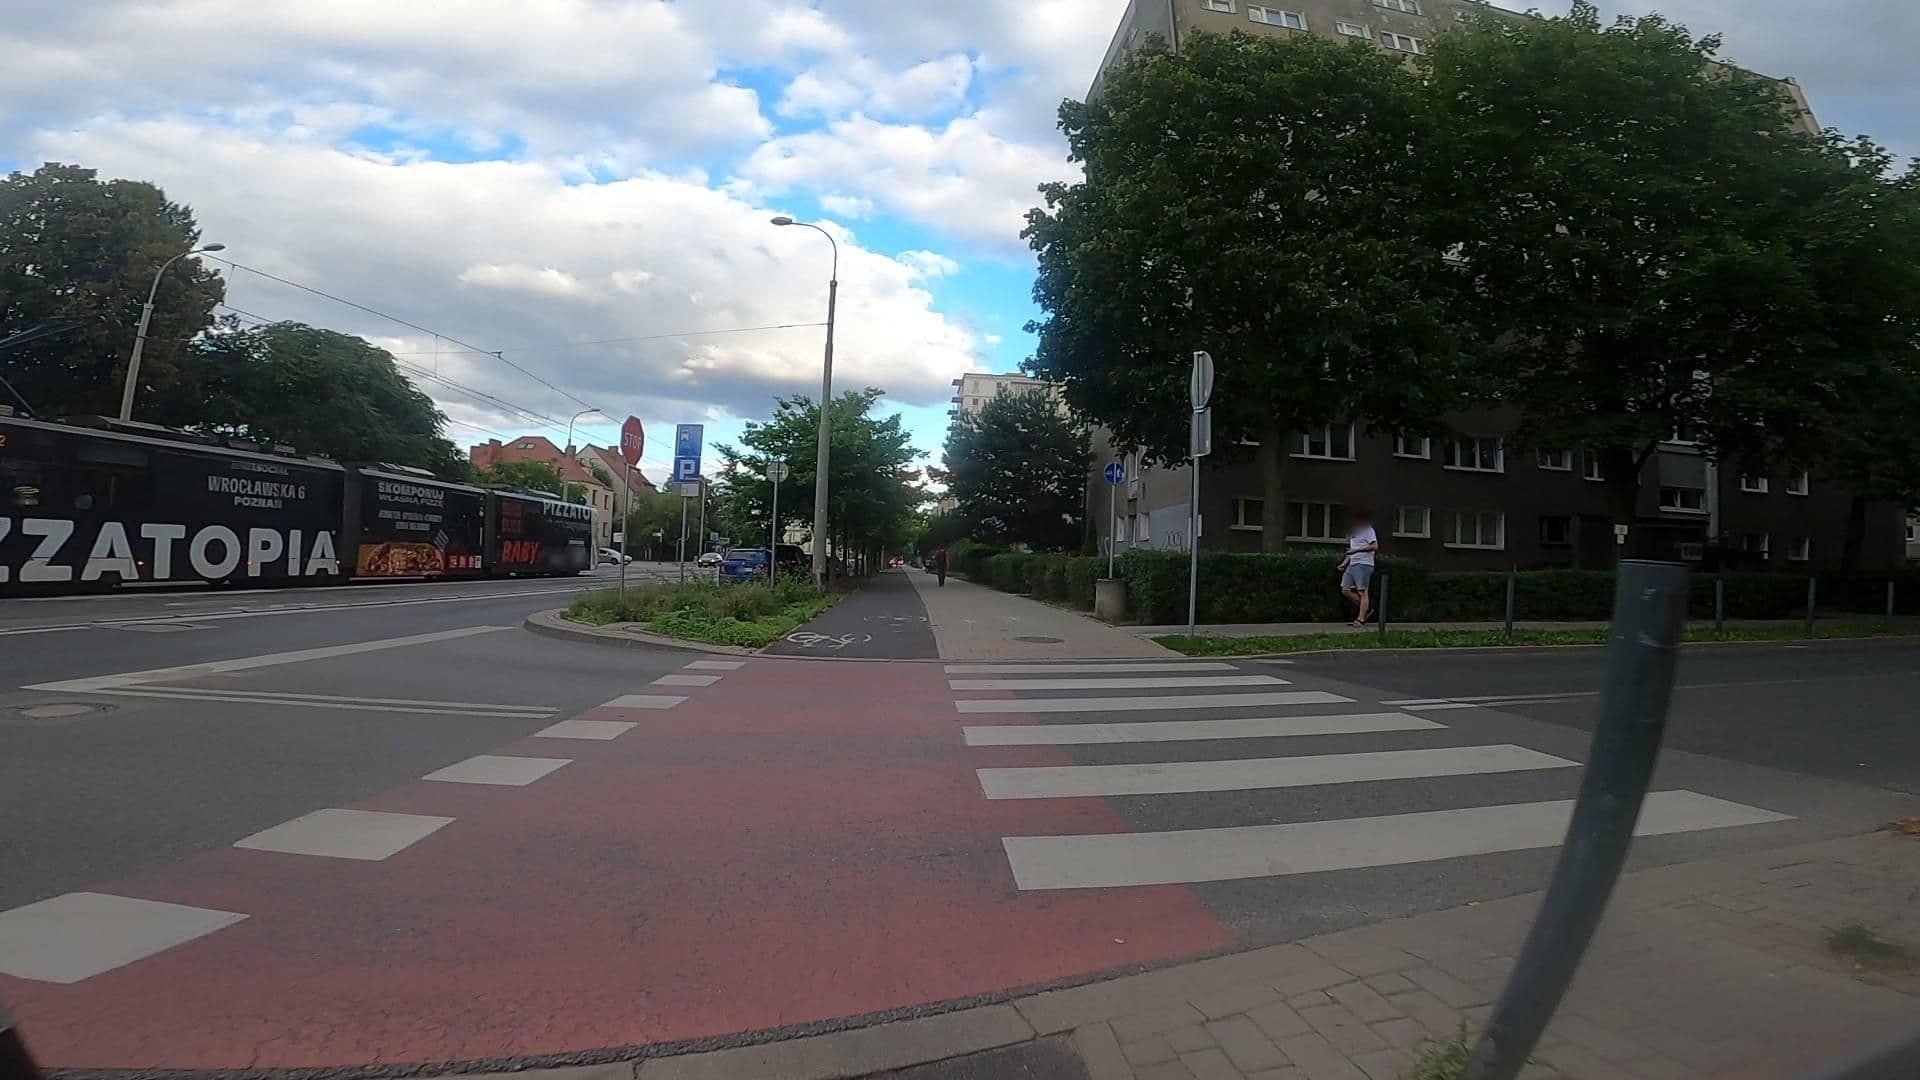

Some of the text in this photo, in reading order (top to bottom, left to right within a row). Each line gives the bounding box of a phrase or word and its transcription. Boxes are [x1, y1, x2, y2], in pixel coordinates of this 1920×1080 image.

[624, 432, 642, 449] STOP
[679, 459, 696, 481] P
[208, 475, 306, 500] WROCŁAWSKA 6
[378, 481, 444, 500] SKOMPONUJ
[0, 517, 339, 583] ZATOPIA
[502, 540, 540, 565] BABY
